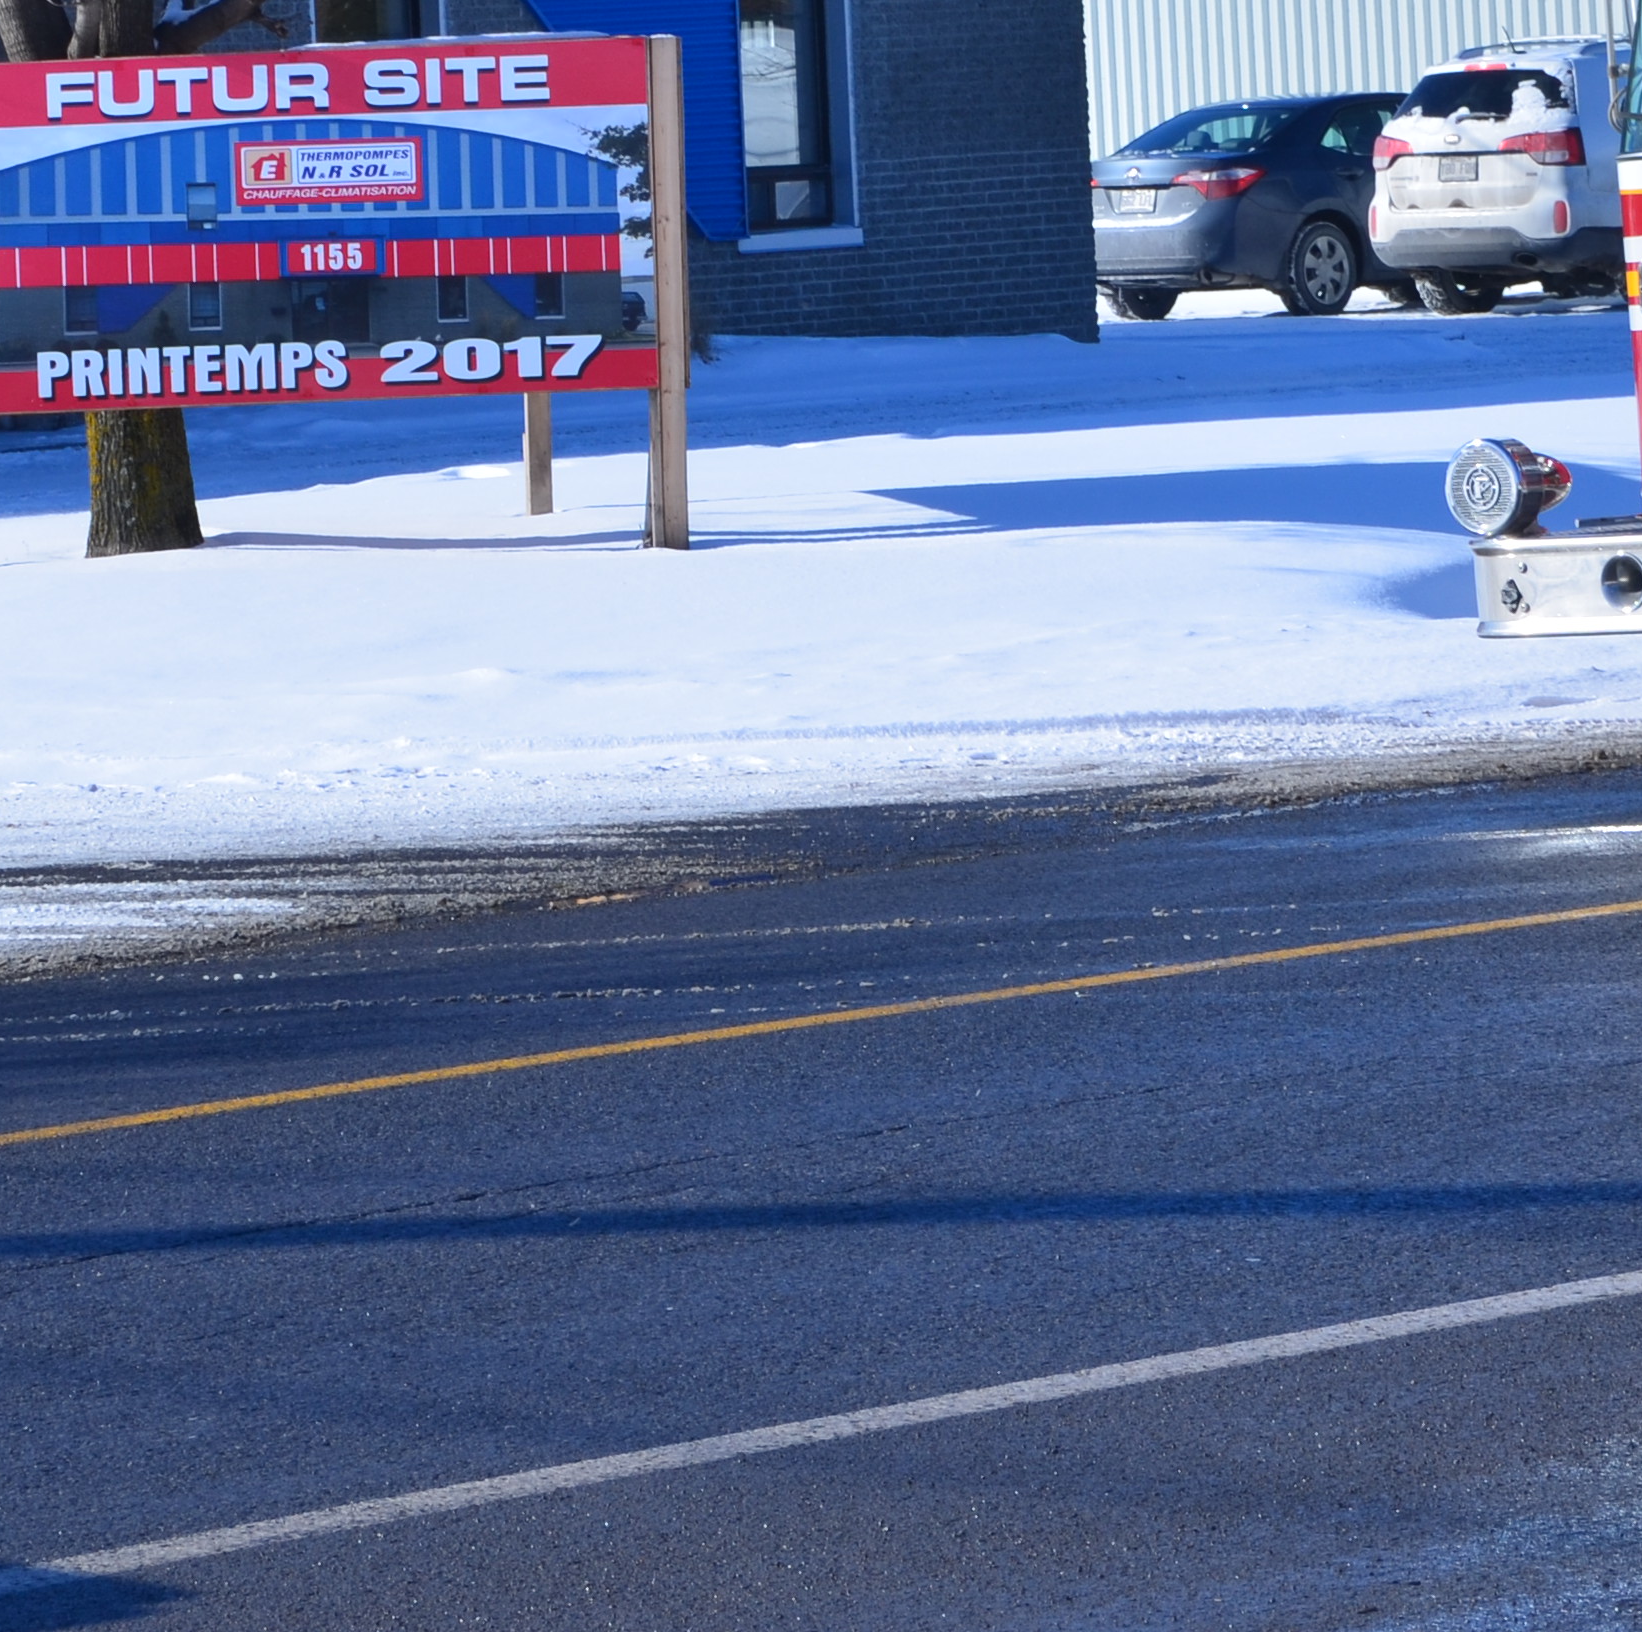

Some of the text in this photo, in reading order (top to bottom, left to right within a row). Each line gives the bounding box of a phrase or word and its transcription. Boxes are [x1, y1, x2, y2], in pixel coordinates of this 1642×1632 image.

[46, 54, 551, 119] FUTUR SITE
[300, 149, 409, 162] THERMOPOMPES
[301, 166, 317, 179] N
[328, 165, 342, 179] R
[350, 164, 390, 178] SOL
[243, 185, 417, 200] CHAUFFAGE-CLIMATISATION
[301, 242, 363, 271] 1155
[37, 334, 603, 399] PRINTEMPS 2017
